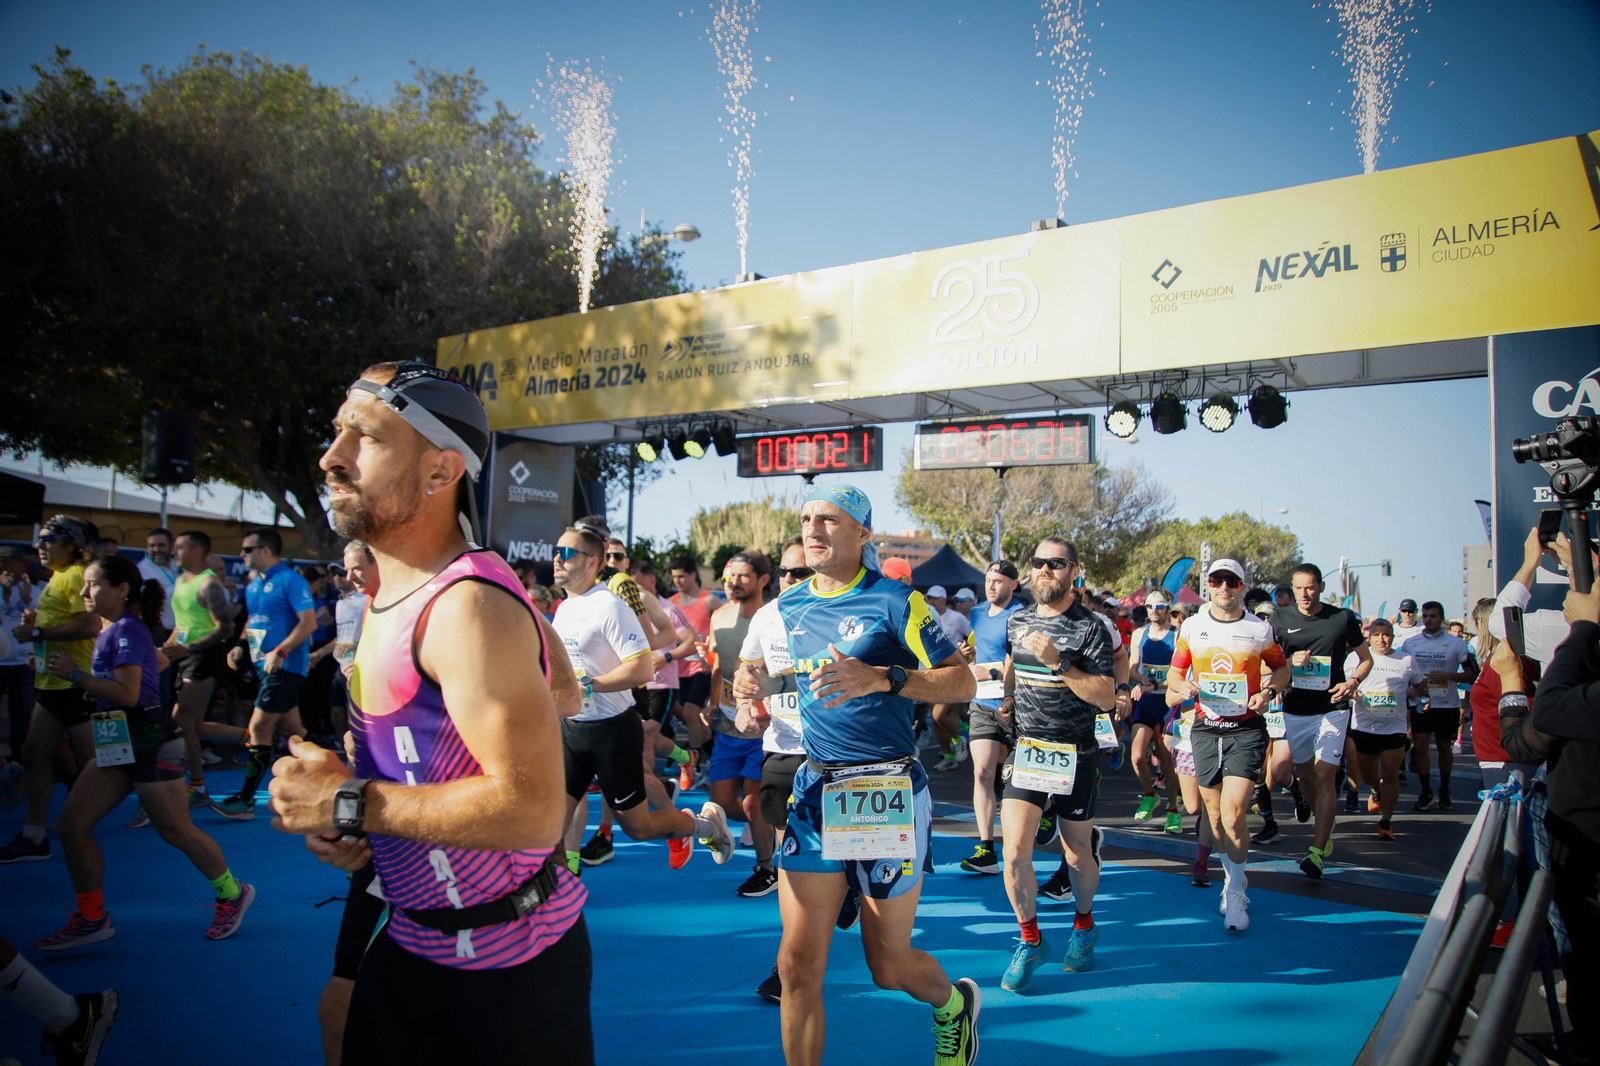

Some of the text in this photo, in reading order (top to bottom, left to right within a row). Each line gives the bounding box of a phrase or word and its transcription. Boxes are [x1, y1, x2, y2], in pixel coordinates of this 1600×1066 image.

[1432, 208, 1560, 247] ALMERÍA
[1432, 243, 1495, 263] CIUDAD
[929, 248, 1040, 345] 25
[1150, 285, 1234, 304] COOPERACIÓN
[1262, 283, 1283, 292] 2020
[1150, 302, 1178, 315] 2005
[527, 341, 649, 372] Medio Maratón
[500, 358, 516, 376] 25
[657, 352, 810, 382] RAMÓN RUIZ ANDÚJAR
[525, 362, 647, 396] Almería 2024
[508, 485, 559, 499] COOPERACIÓN
[1209, 681, 1238, 694] 372
[1024, 747, 1070, 768] 1815
[834, 790, 906, 815] 1704
